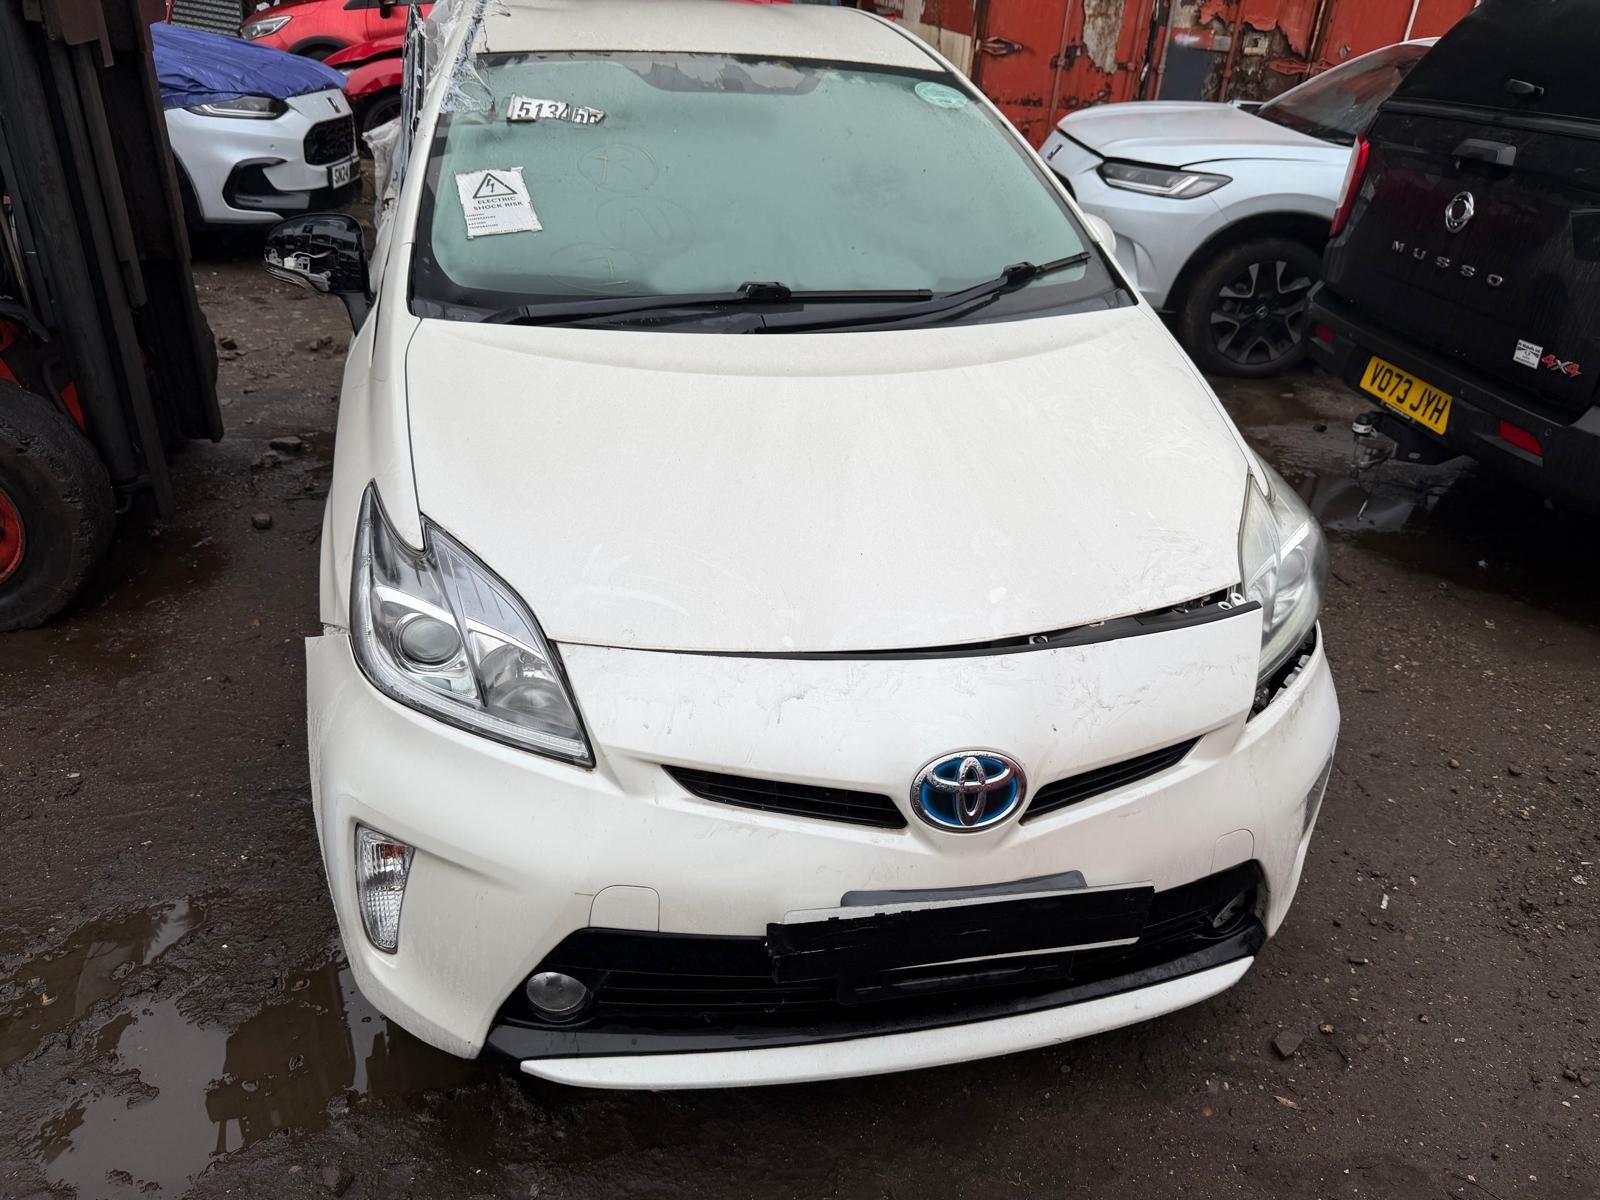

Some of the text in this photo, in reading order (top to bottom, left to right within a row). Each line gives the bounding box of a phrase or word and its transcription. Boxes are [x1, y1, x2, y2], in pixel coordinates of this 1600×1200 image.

[473, 203, 503, 211] SHOCK
[477, 196, 516, 205] ELECTRIC
[1391, 239, 1503, 287] MUSSO
[1409, 388, 1448, 425] JYH
